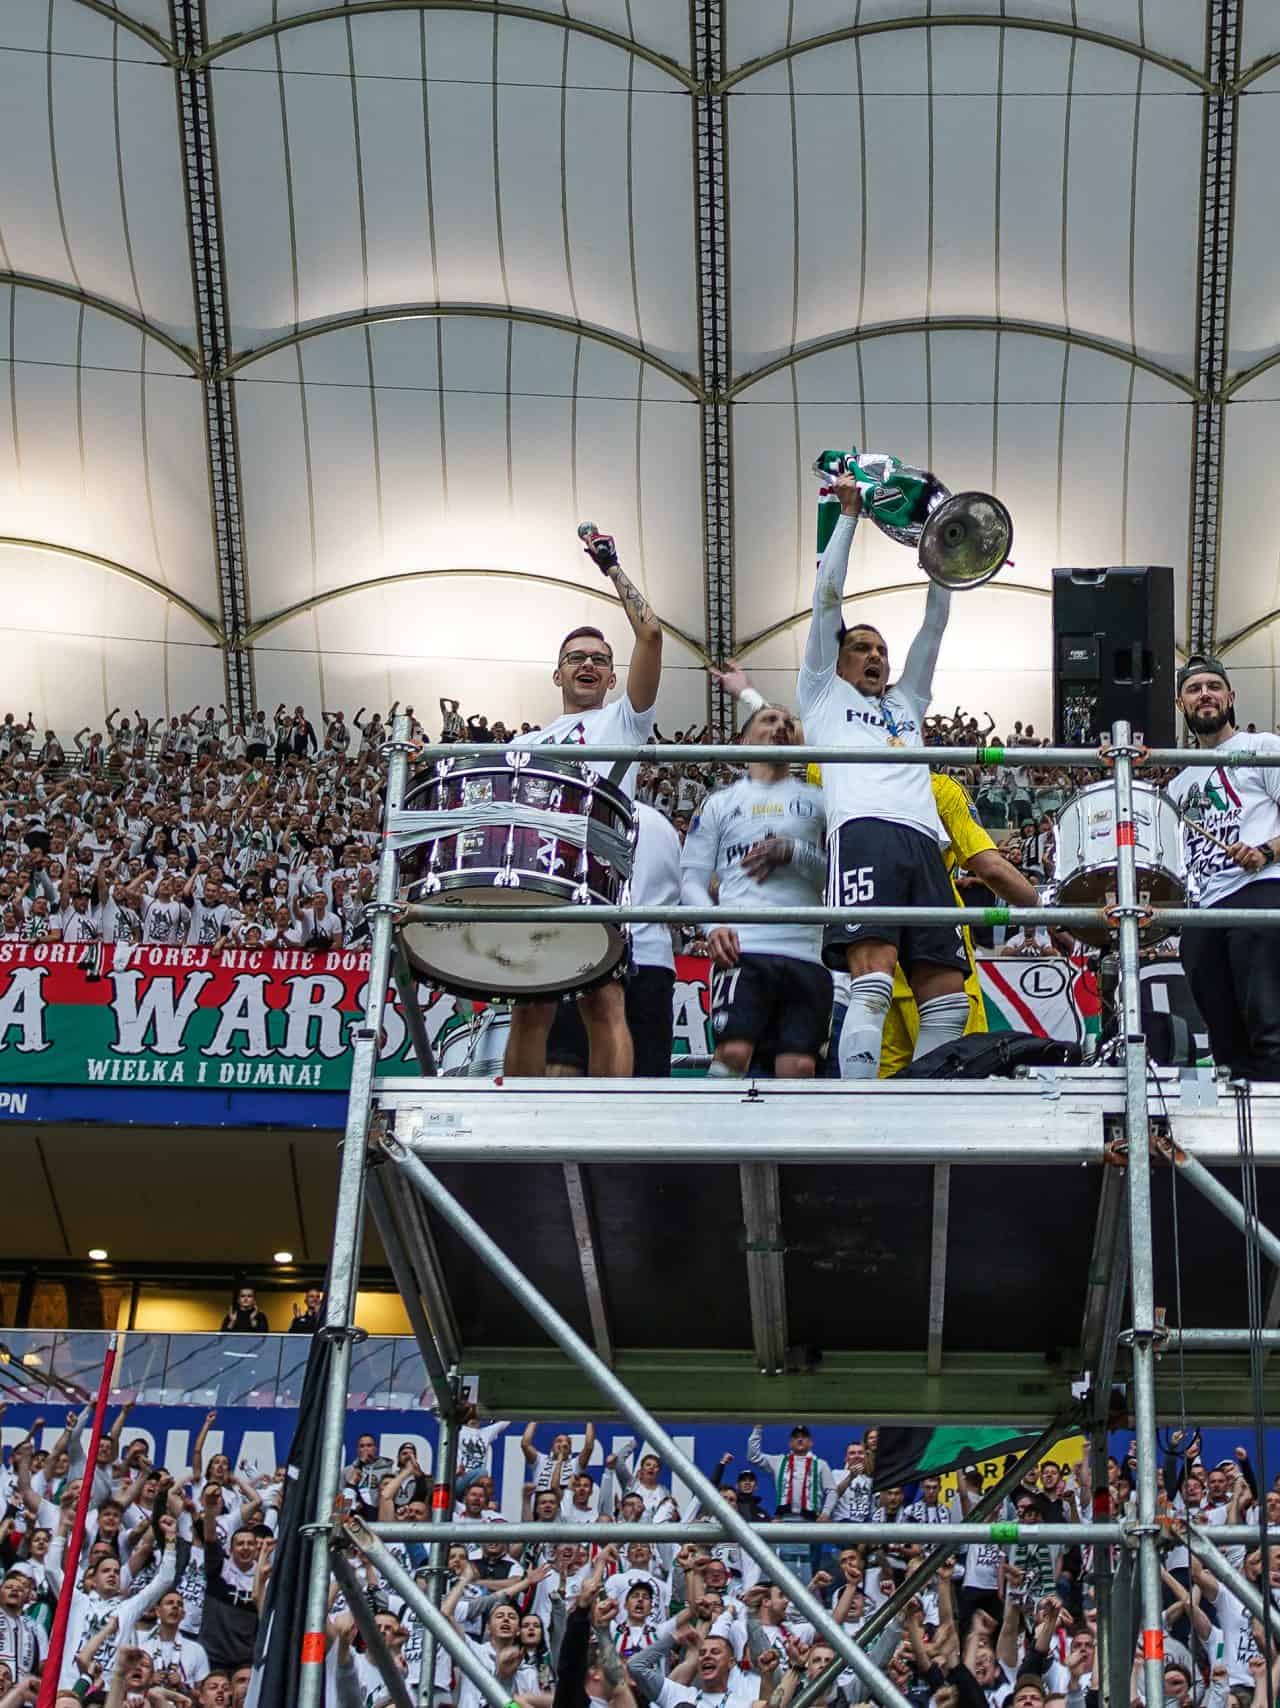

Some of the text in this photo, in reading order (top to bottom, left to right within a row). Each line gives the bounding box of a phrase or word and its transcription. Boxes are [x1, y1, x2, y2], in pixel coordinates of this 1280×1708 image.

[843, 866, 874, 905] 55
[132, 943, 211, 967] TÓREJ
[221, 949, 263, 970] NIC
[272, 950, 314, 971] NIE
[325, 951, 371, 971] DOR
[712, 967, 741, 1009] 27
[87, 1059, 323, 1086] WIELKA I DUMNA!
